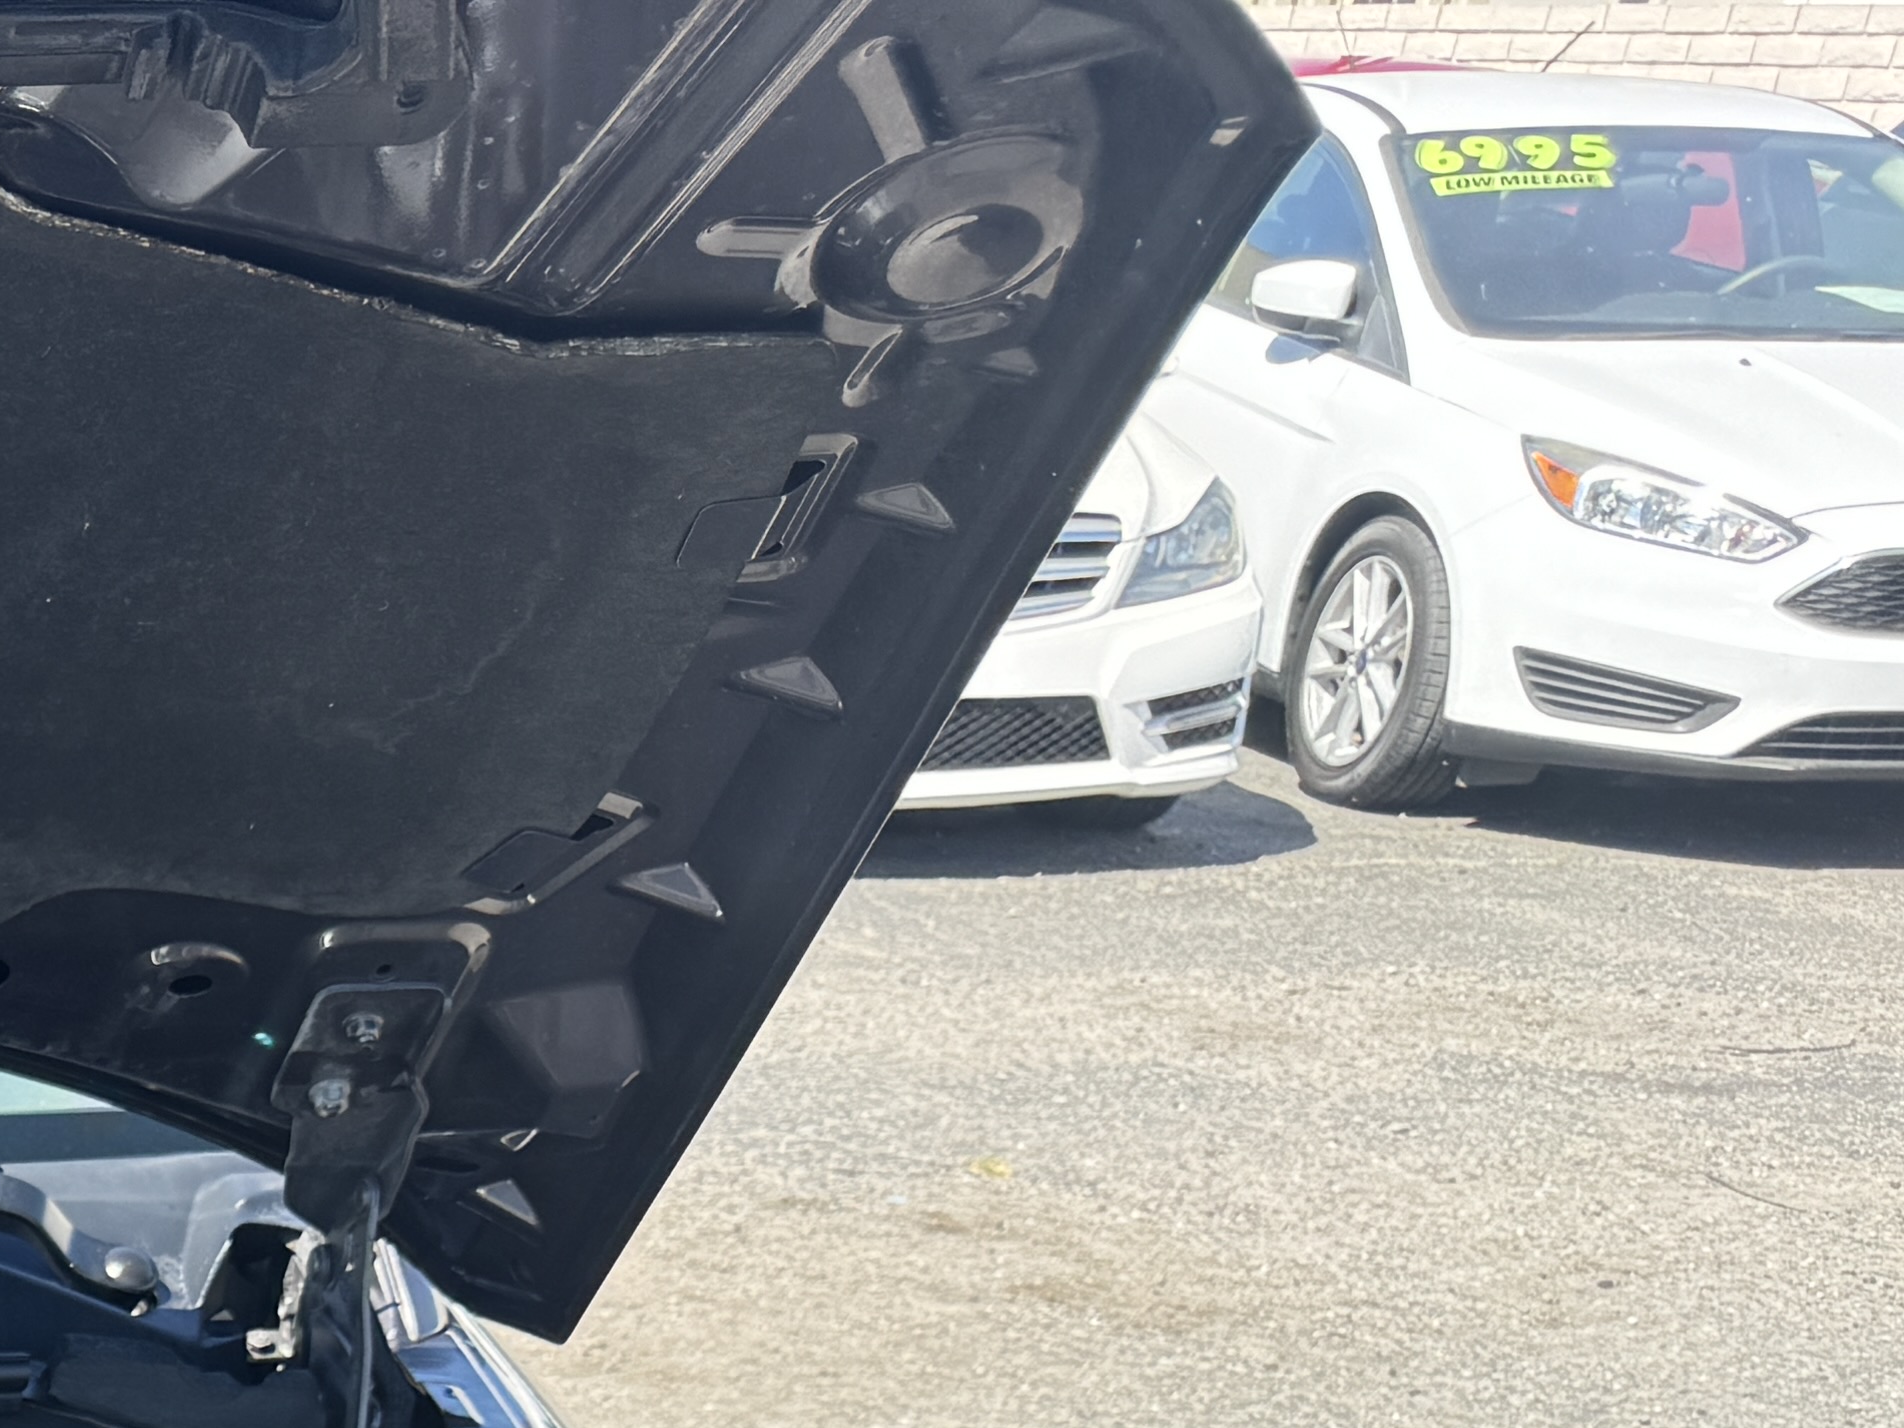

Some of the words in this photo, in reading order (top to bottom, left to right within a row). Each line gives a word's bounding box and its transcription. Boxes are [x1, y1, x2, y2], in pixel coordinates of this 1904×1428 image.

[1415, 134, 1617, 174] 6995
[1445, 177, 1492, 191] LOW
[1500, 173, 1601, 187] MILEAGE
